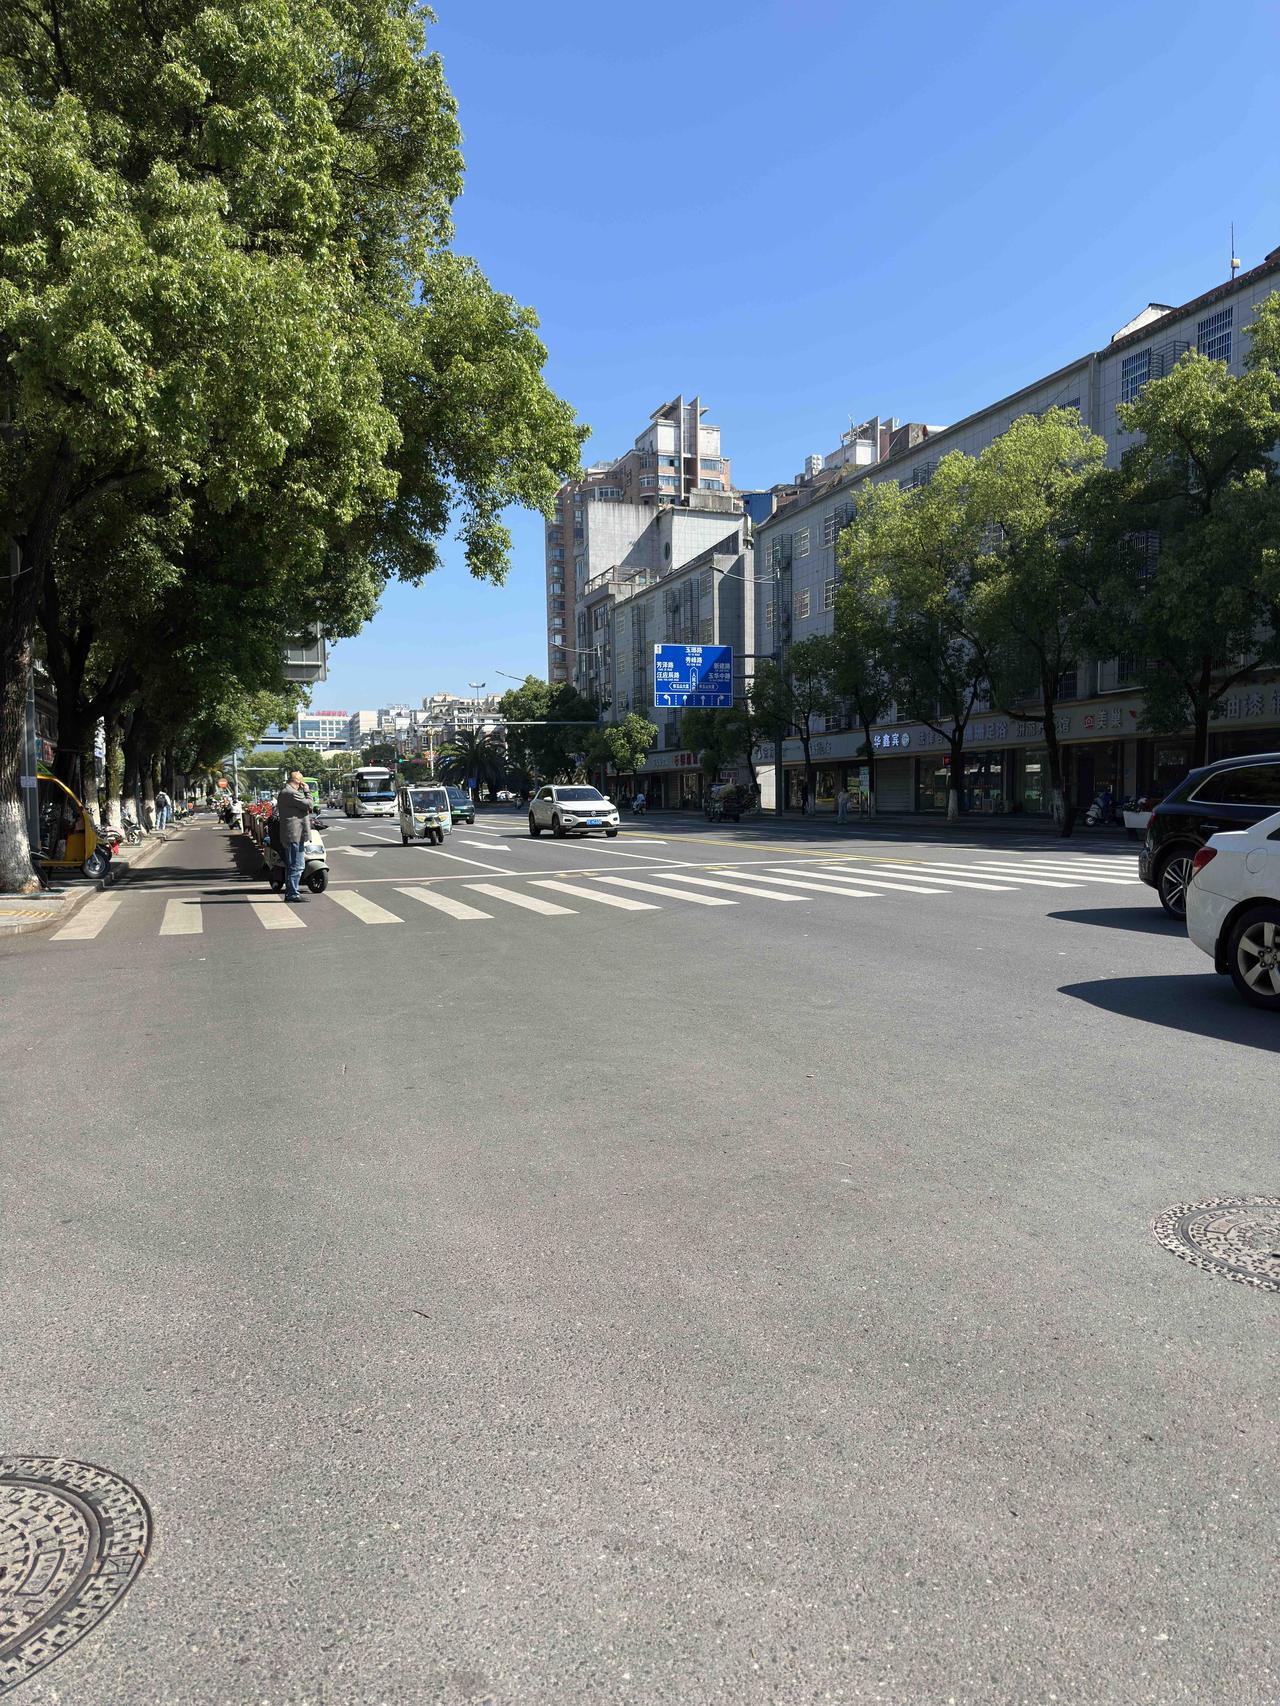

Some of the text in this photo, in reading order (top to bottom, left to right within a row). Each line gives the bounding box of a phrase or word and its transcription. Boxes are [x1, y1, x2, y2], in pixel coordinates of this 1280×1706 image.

[685, 656, 702, 664] 秀峰路
[656, 661, 674, 669] 芳泽路
